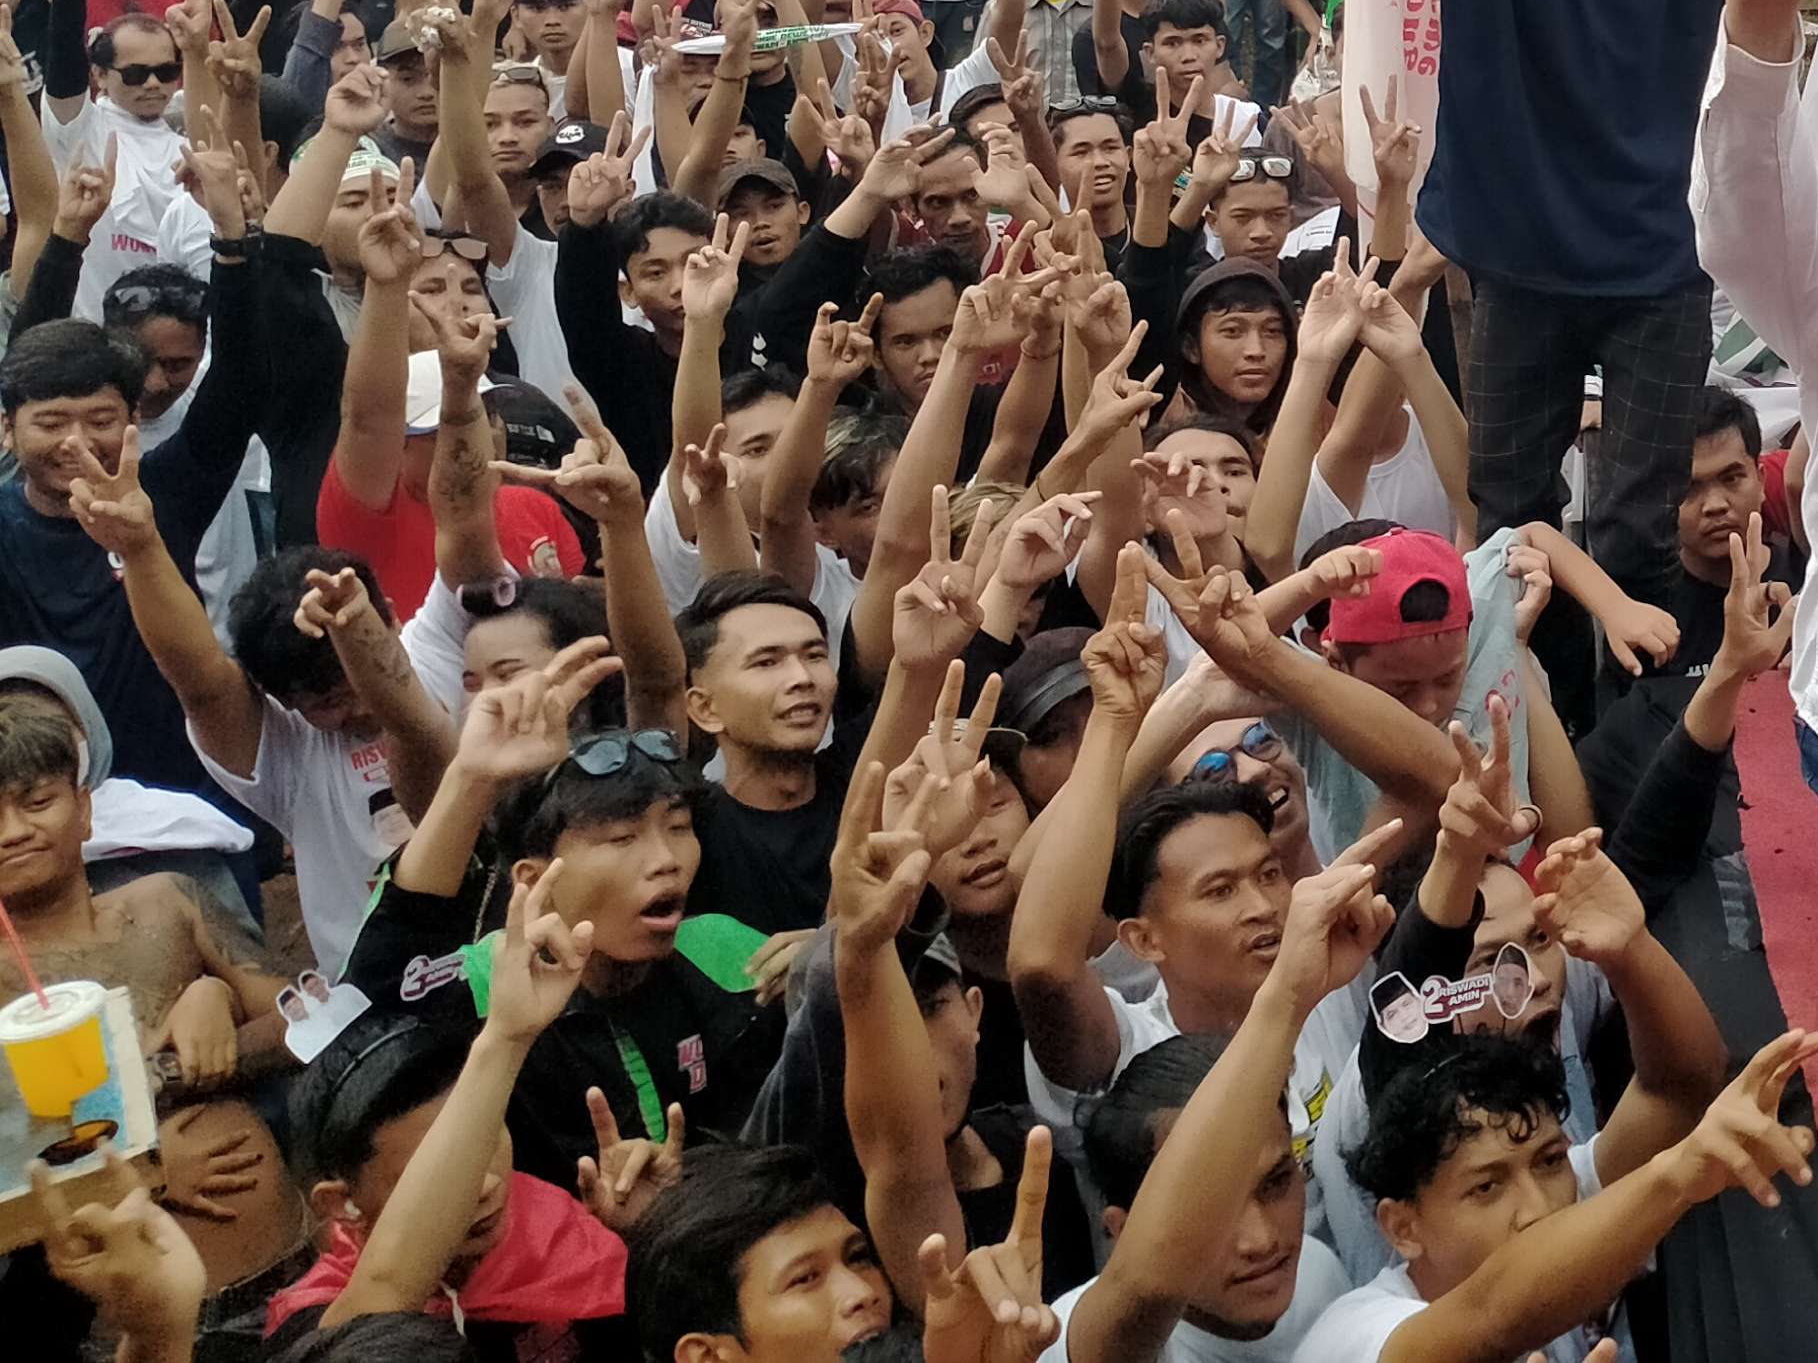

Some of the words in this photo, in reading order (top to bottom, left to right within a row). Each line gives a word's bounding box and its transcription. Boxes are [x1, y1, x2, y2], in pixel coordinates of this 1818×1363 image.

[1423, 979, 1444, 1014] 2
[1440, 977, 1489, 997] RISWADI
[1448, 990, 1480, 1007] AMIN
